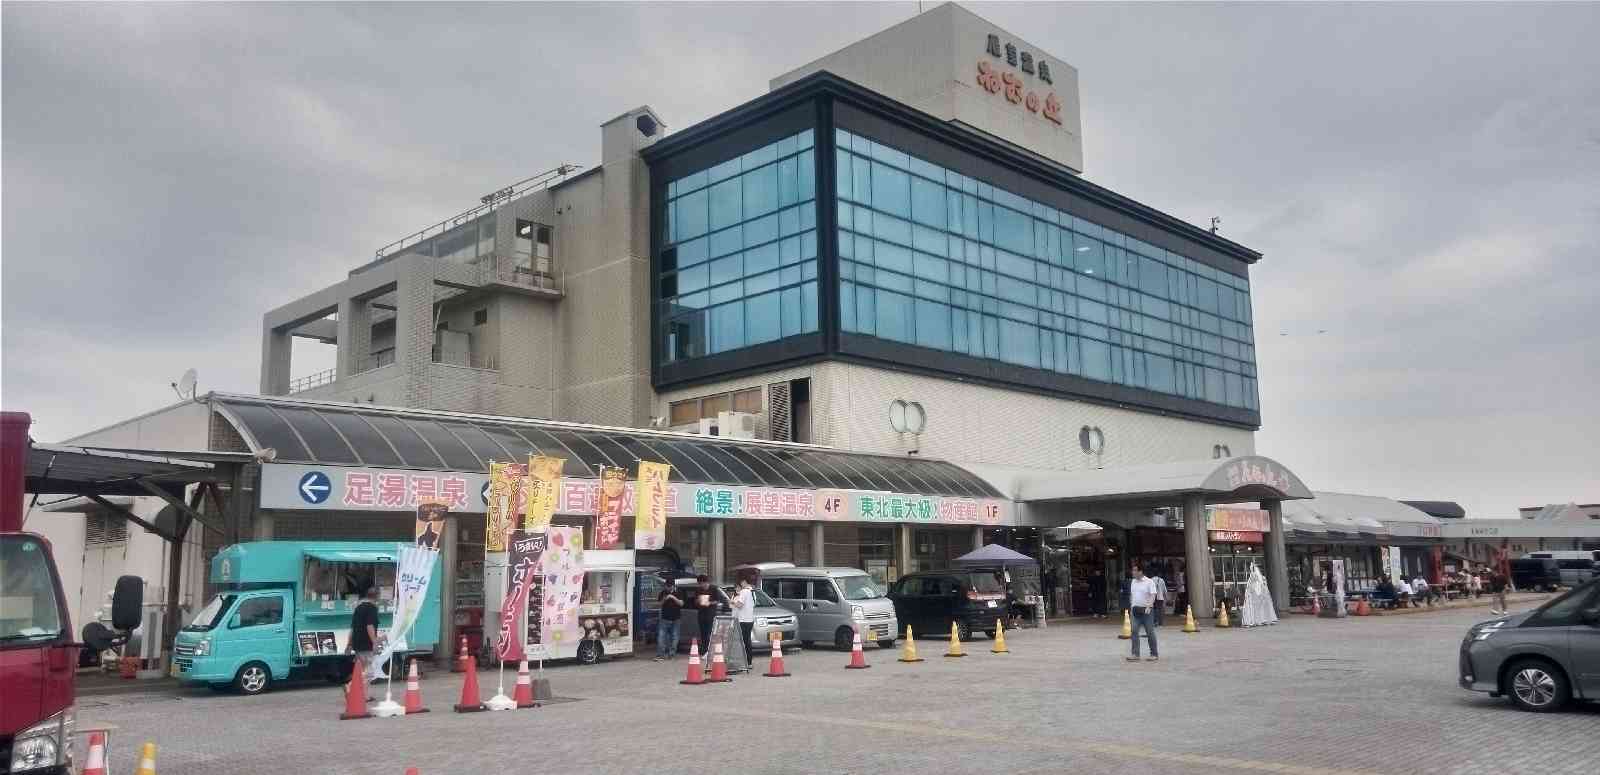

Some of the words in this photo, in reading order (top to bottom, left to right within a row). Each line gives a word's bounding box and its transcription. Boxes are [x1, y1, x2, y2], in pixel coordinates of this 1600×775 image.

[343, 470, 470, 507] 足湯温泉
[824, 497, 842, 513] 4F
[985, 504, 1000, 518] 1F
[401, 572, 426, 587] クリーム
